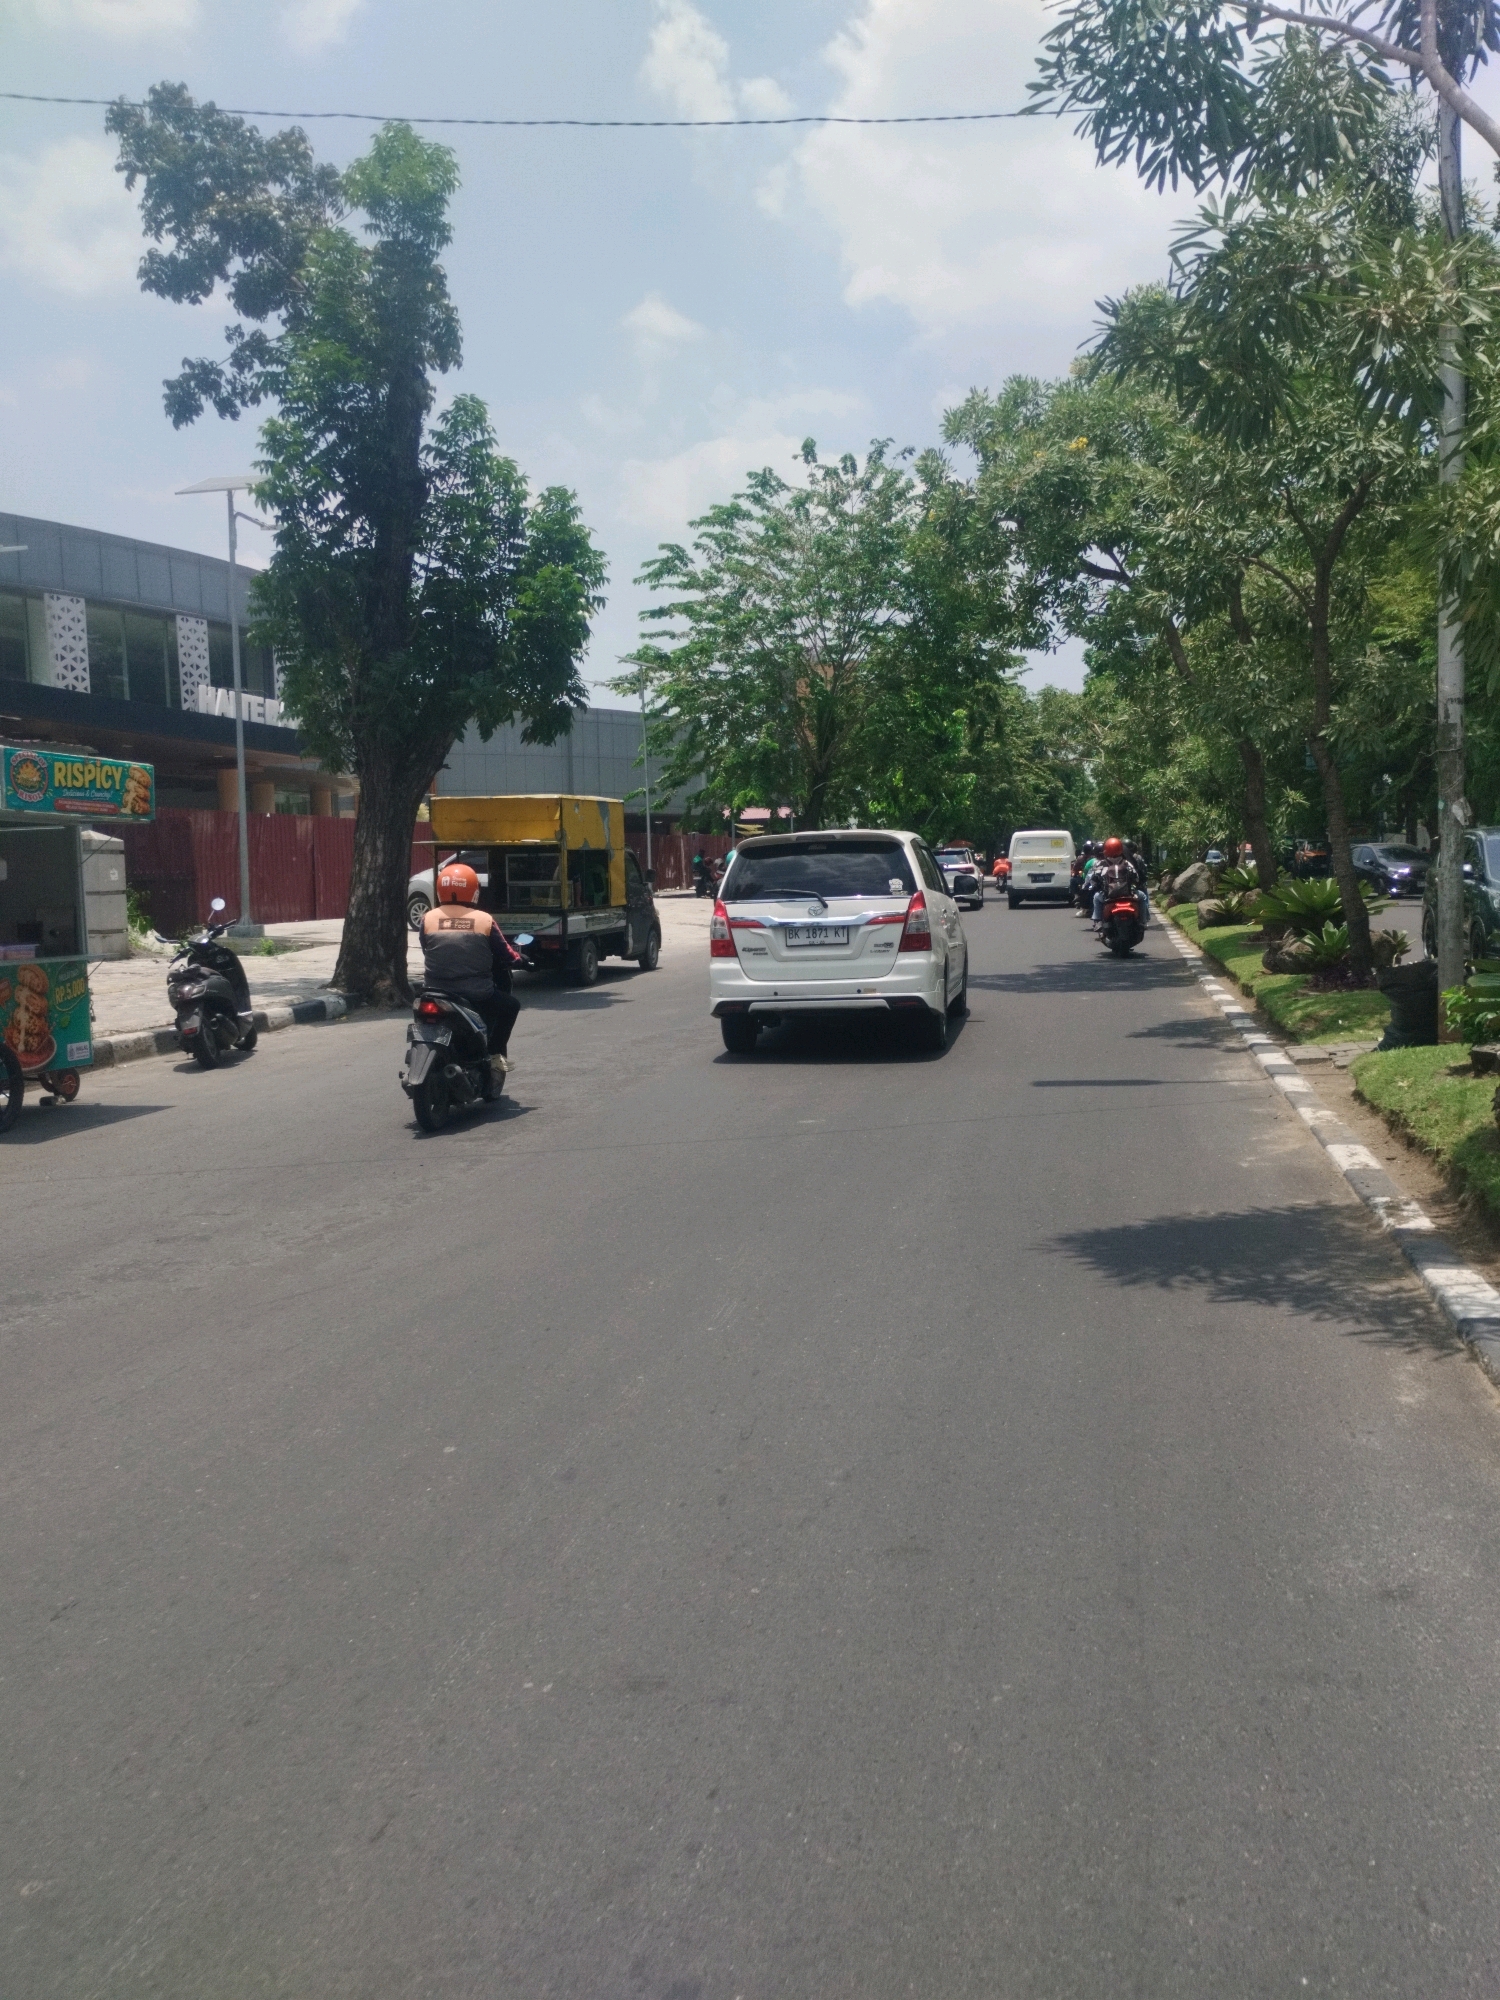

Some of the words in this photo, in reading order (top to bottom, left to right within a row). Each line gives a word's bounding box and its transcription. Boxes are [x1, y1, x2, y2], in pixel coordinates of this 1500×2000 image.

[788, 928, 800, 939] BK
[806, 927, 829, 938] 1871
[834, 926, 846, 938] KT
[55, 977, 85, 1004] RP.5.000
